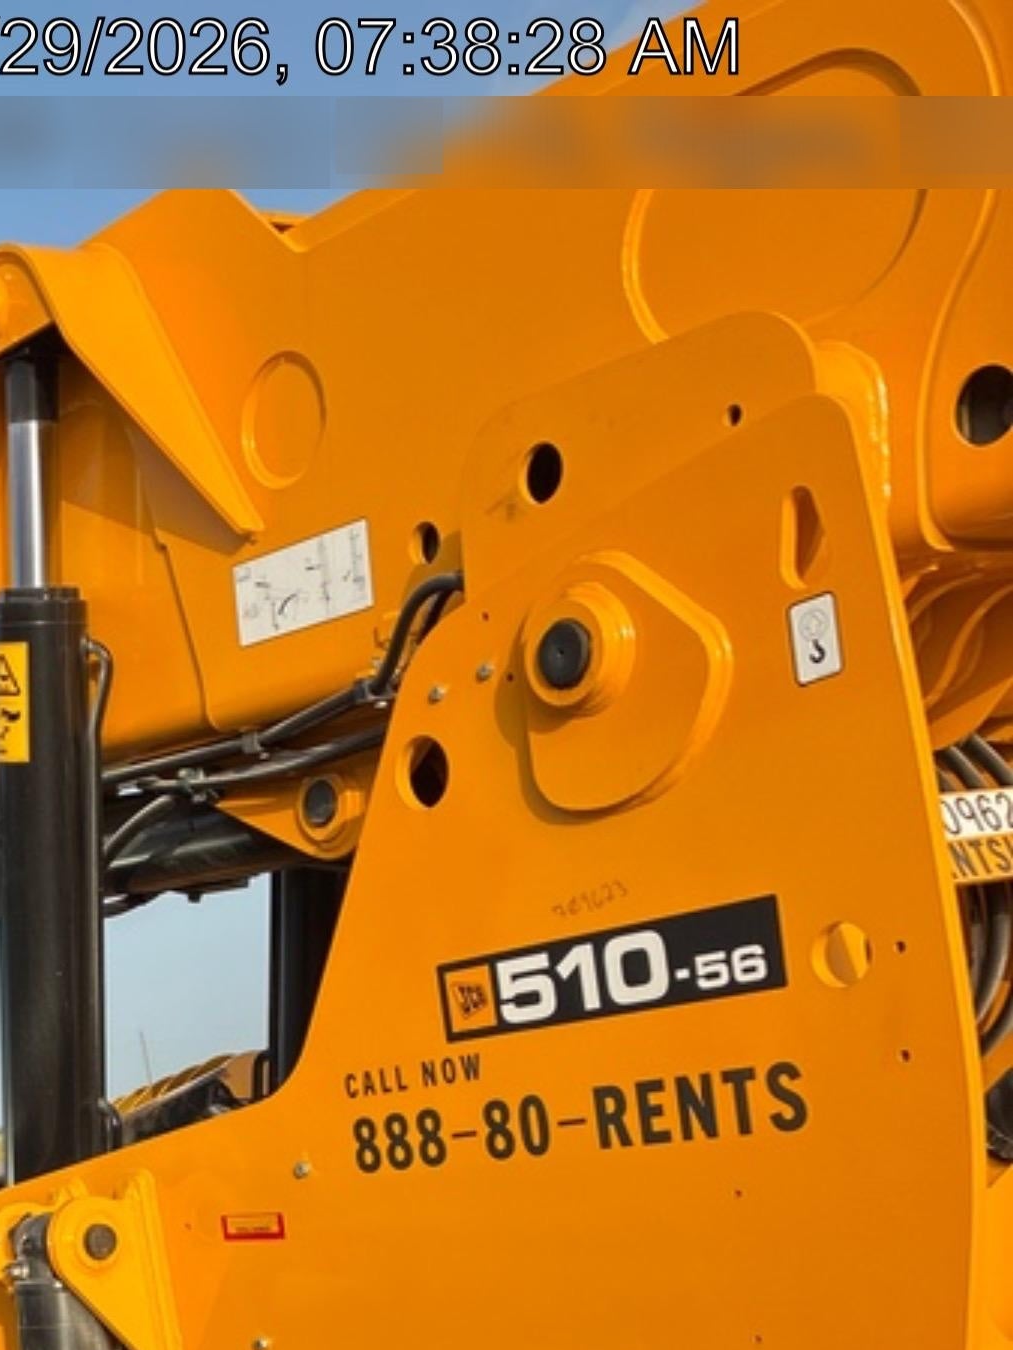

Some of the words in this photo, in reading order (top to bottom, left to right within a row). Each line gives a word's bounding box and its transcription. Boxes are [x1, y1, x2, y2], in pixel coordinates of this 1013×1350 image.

[495, 929, 769, 1024] 510-56
[343, 1064, 409, 1099] CALL
[420, 1053, 483, 1087] NOW
[352, 1061, 809, 1174] 888-80-RENTS
